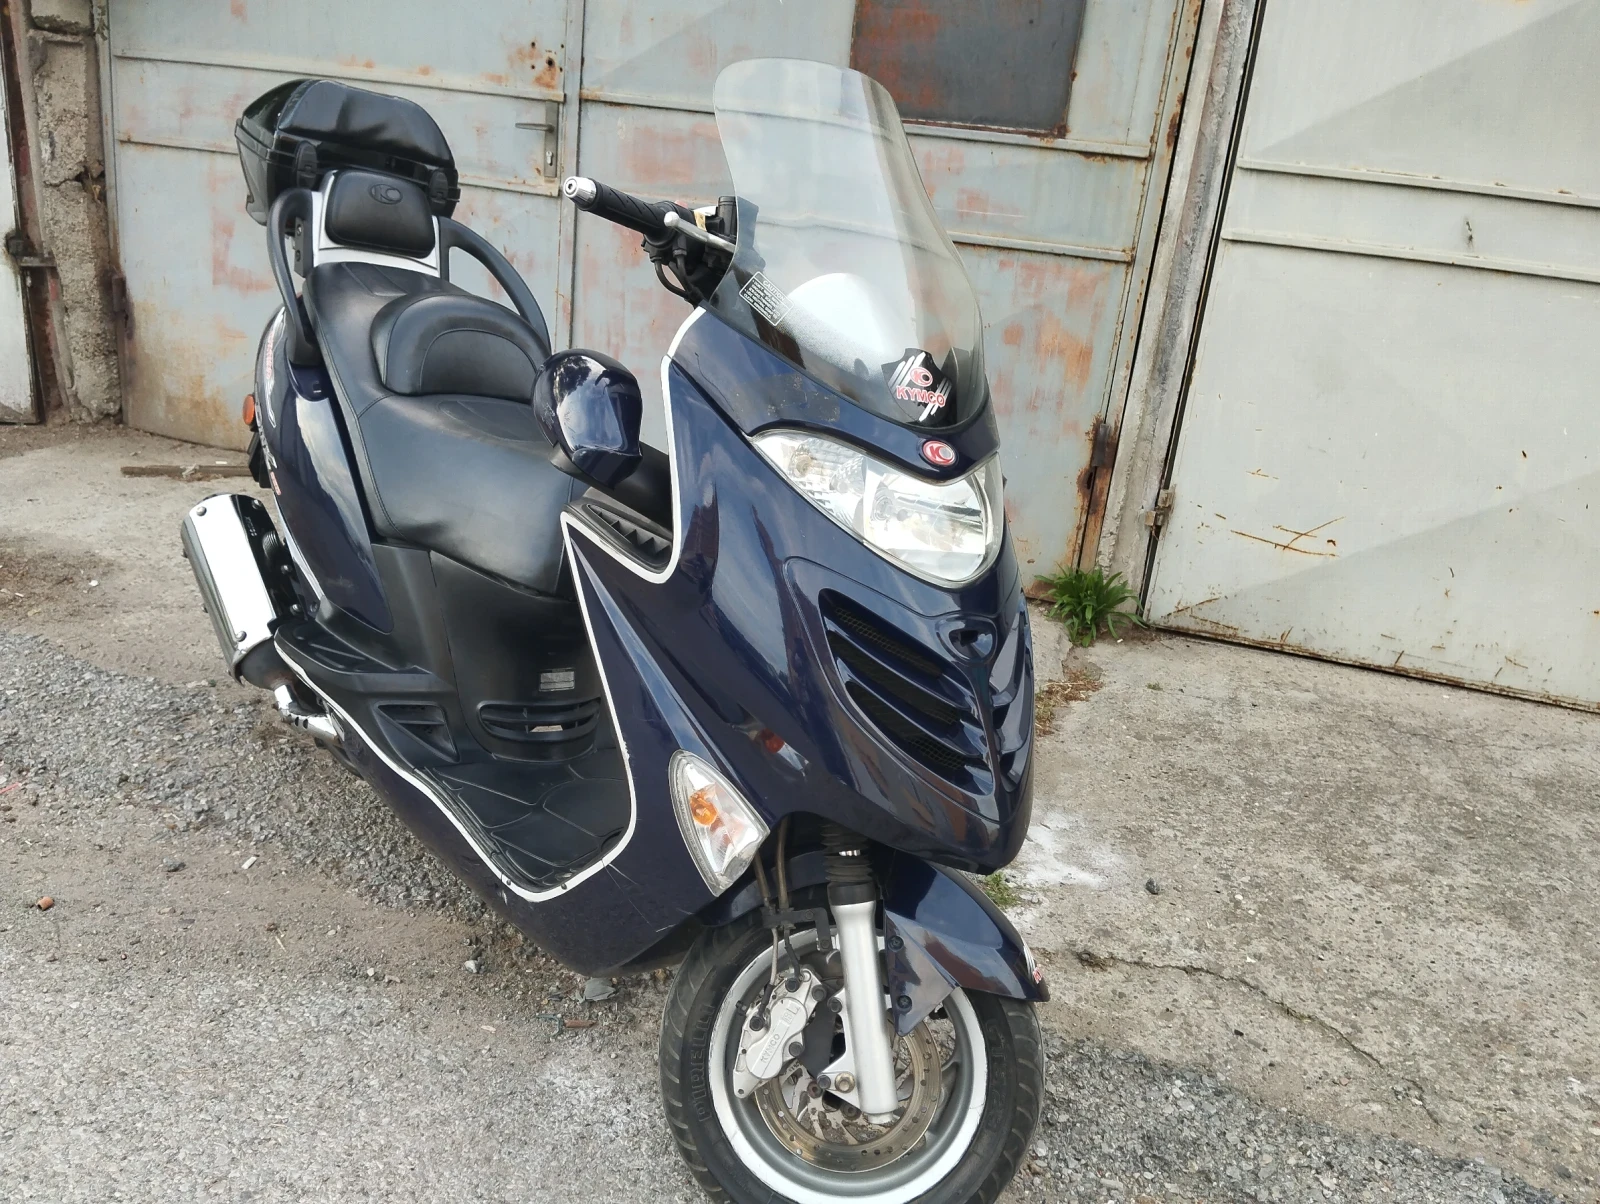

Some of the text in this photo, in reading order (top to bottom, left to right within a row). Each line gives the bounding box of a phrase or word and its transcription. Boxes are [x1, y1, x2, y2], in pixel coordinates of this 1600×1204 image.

[763, 280, 785, 301] CAUTION
[896, 385, 946, 407] KYMCO
[760, 1033, 781, 1064] KYMCO
[690, 1004, 716, 1122] PIRELLI
